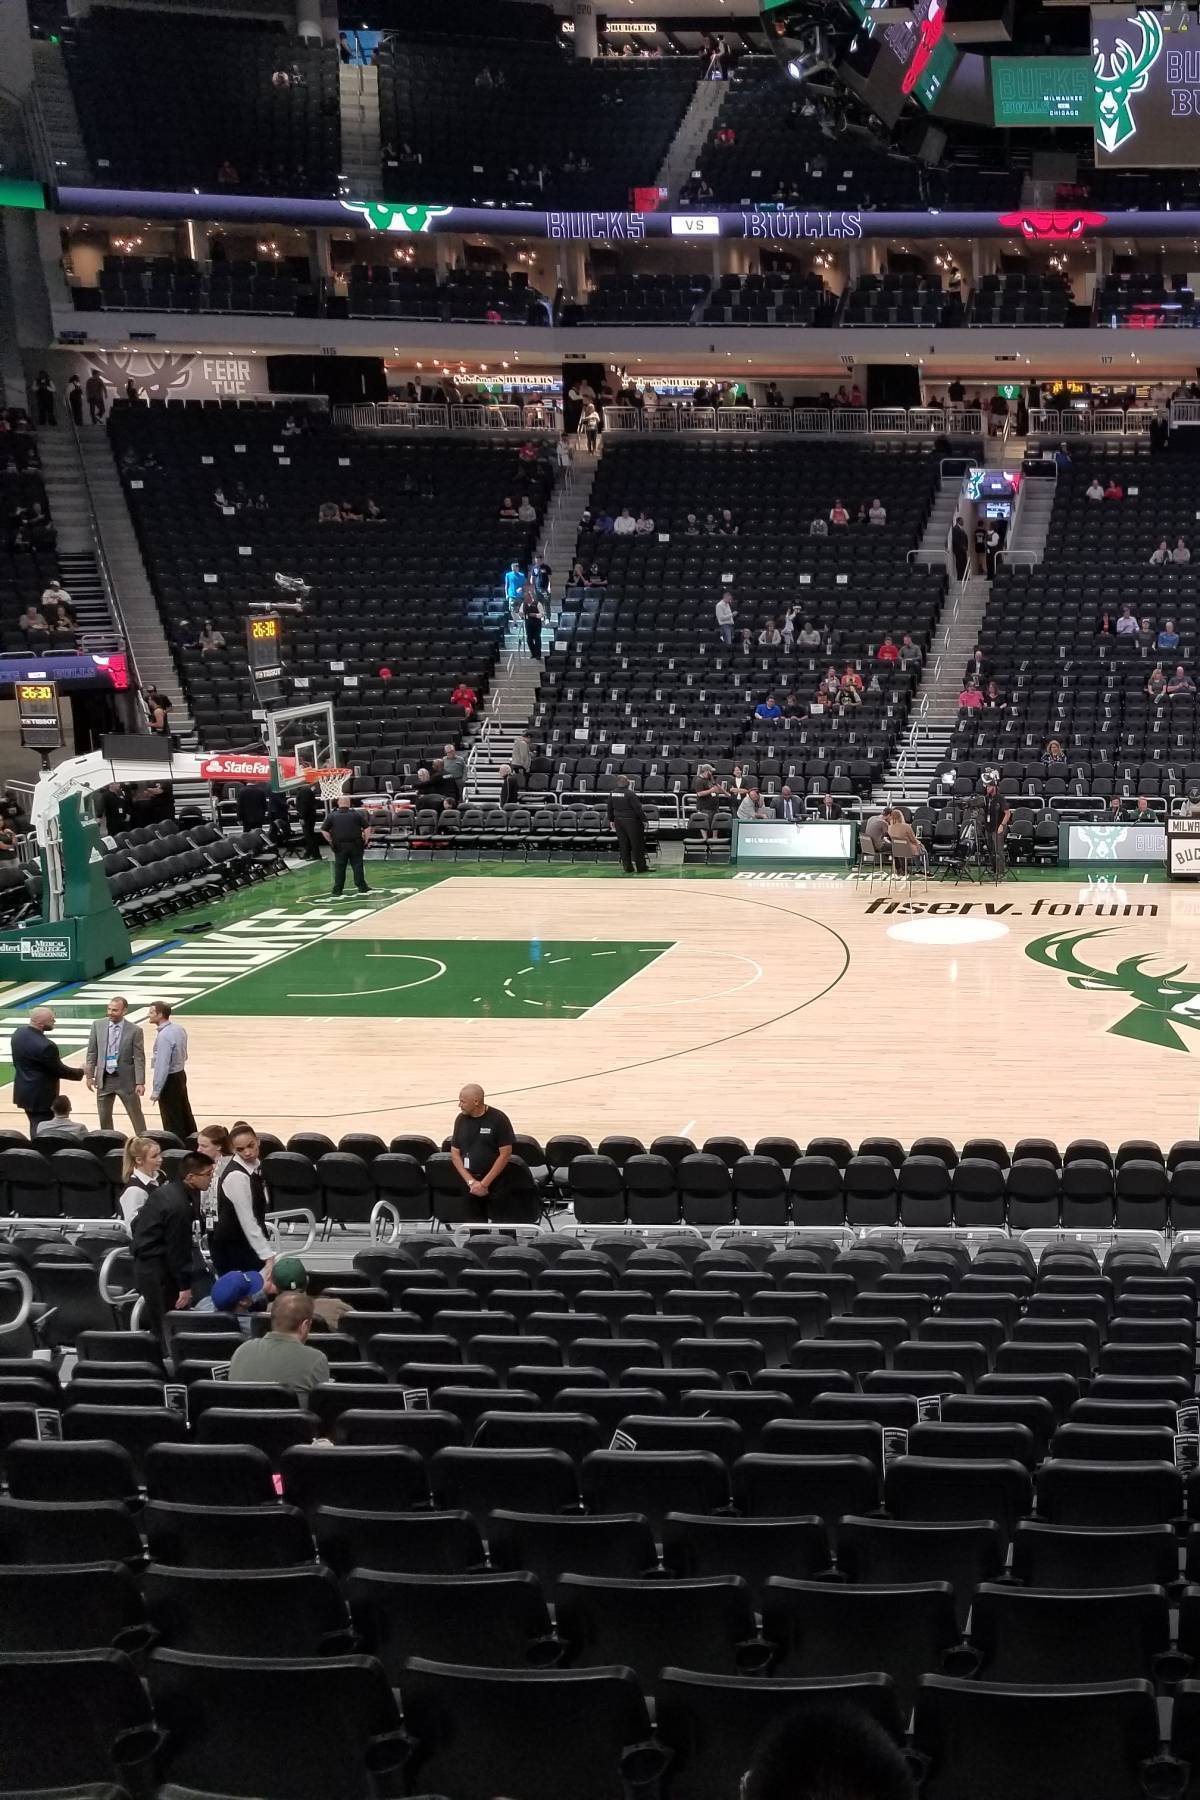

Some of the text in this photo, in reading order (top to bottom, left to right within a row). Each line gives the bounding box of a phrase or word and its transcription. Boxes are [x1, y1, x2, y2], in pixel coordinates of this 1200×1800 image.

[546, 212, 862, 238] BUCKS VS BULLS
[1101, 356, 1113, 364] 117
[203, 360, 250, 381] FEAR
[212, 381, 246, 395] THE
[253, 621, 275, 639] 26:30
[21, 686, 52, 699] 26:30
[31, 718, 57, 726] TISSOT
[1135, 834, 1167, 852] BUC
[0, 943, 20, 952] dtert
